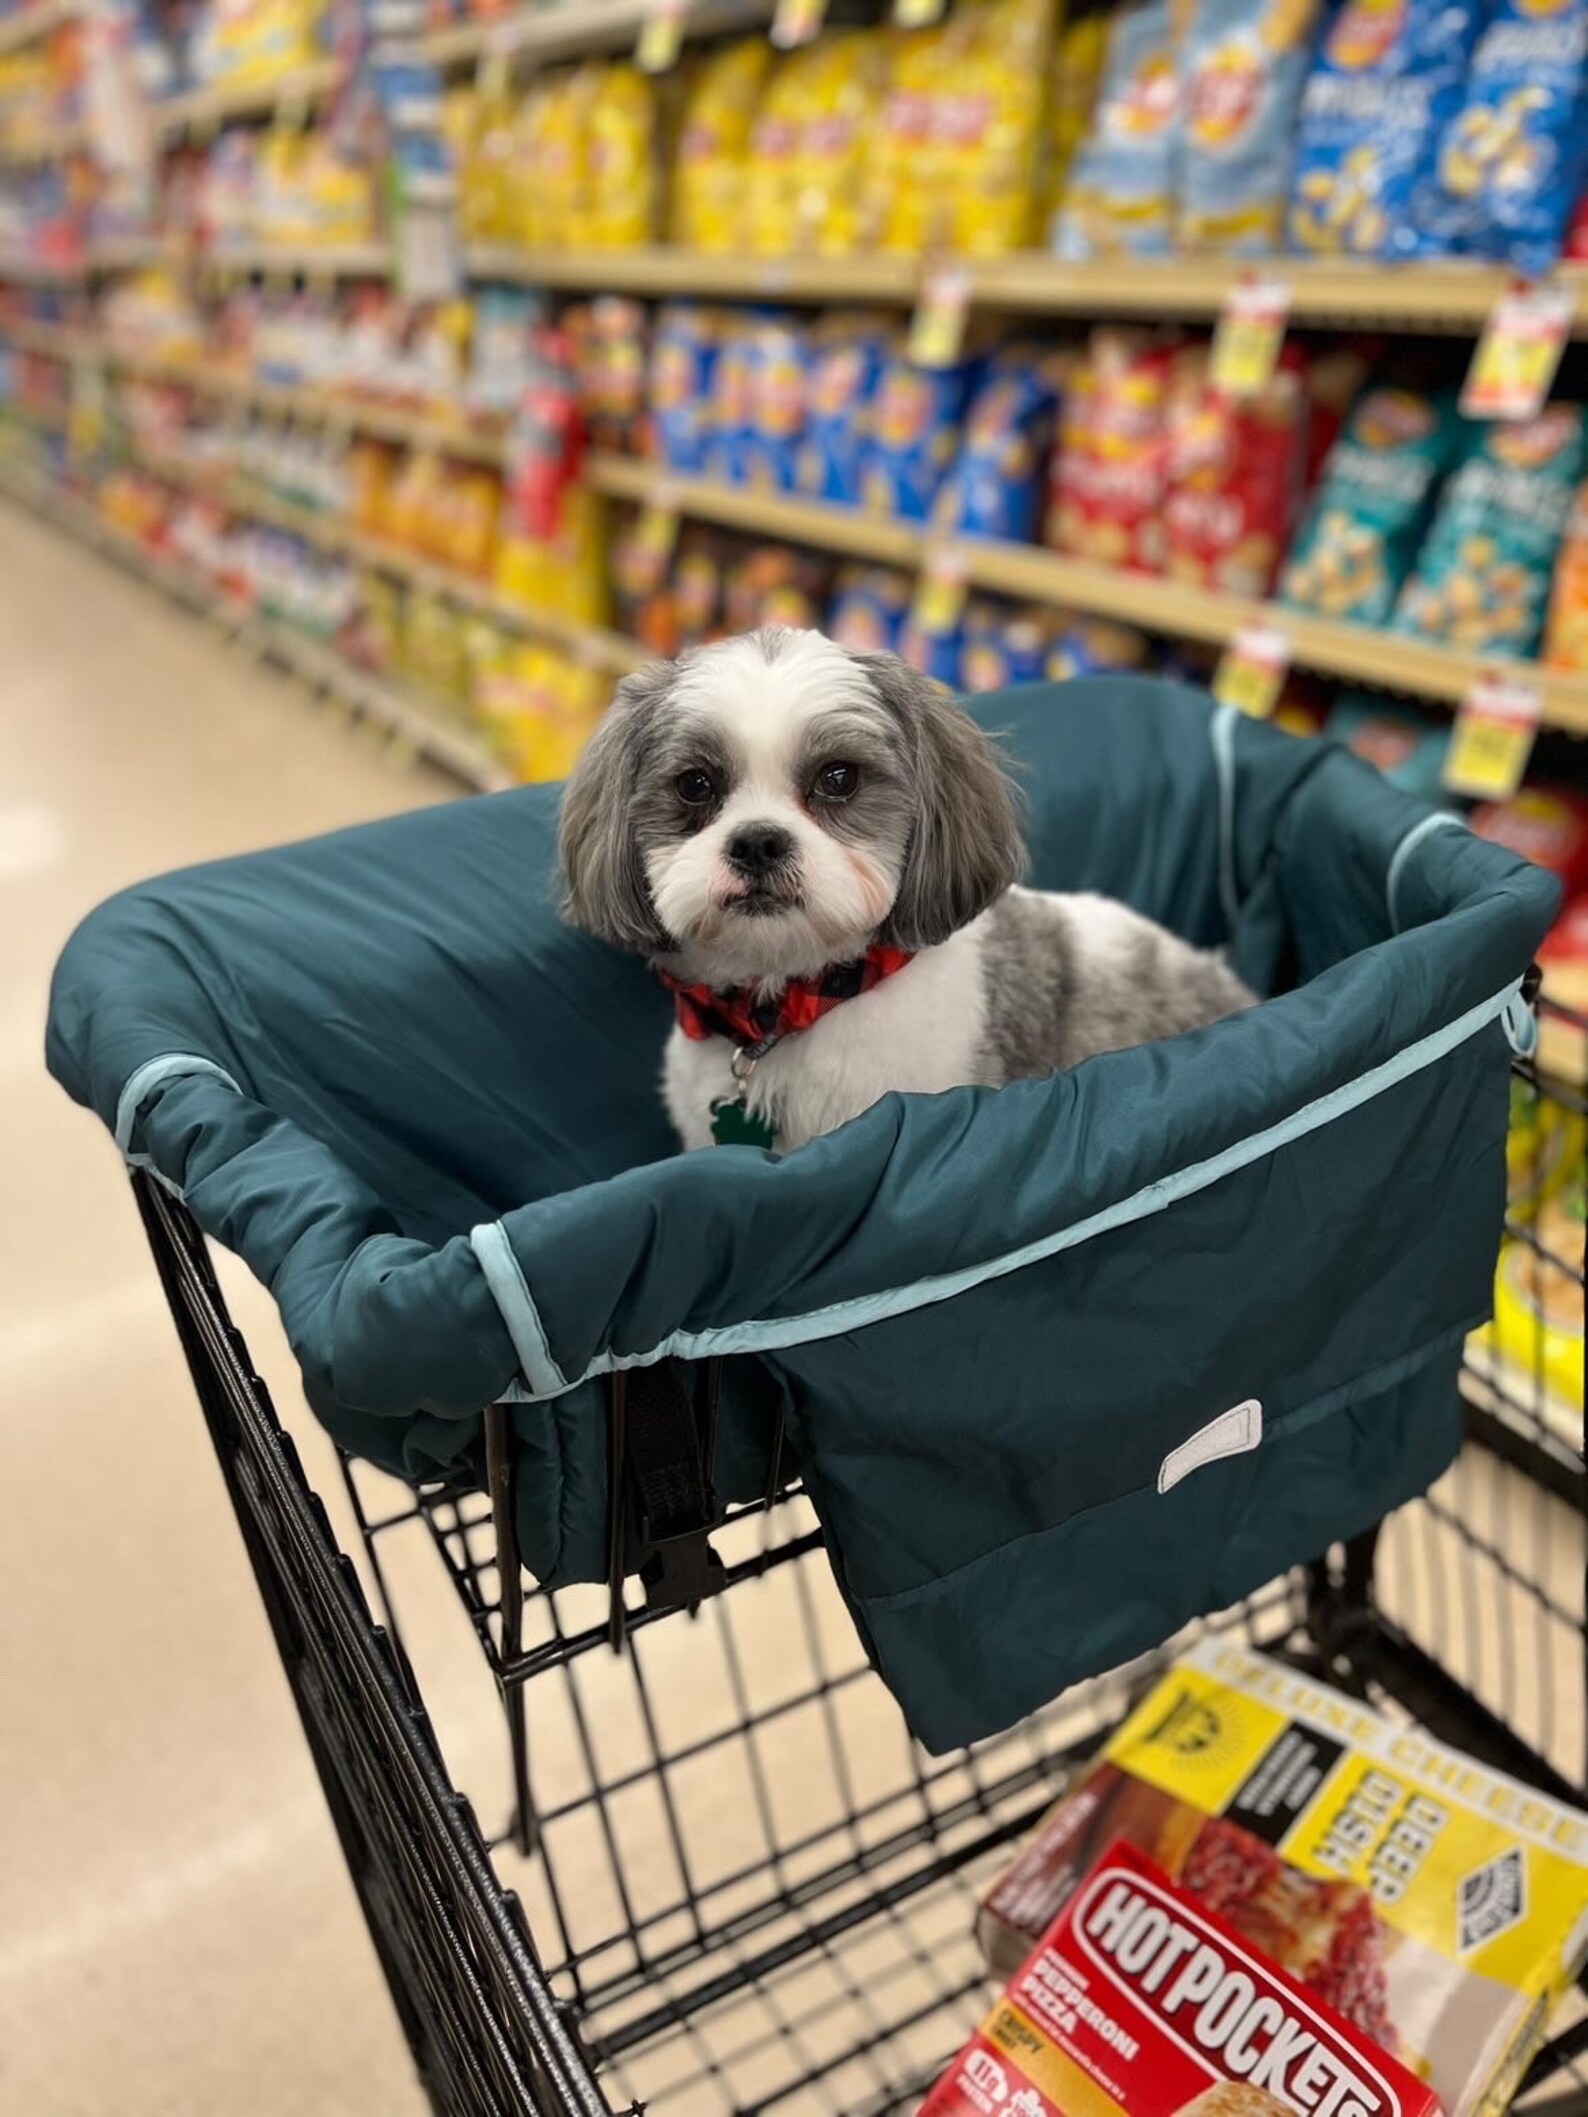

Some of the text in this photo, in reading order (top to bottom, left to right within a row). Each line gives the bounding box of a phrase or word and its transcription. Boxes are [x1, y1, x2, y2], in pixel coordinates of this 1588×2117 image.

[1312, 1767, 1402, 1873] DISH
[1389, 1736, 1580, 1849] CHEESE
[1086, 1882, 1199, 1993] HOT
[999, 2008, 1044, 2055] CRISPY
[1020, 1974, 1077, 2034] PIZZA
[1032, 1958, 1140, 2061] PEPPERONI
